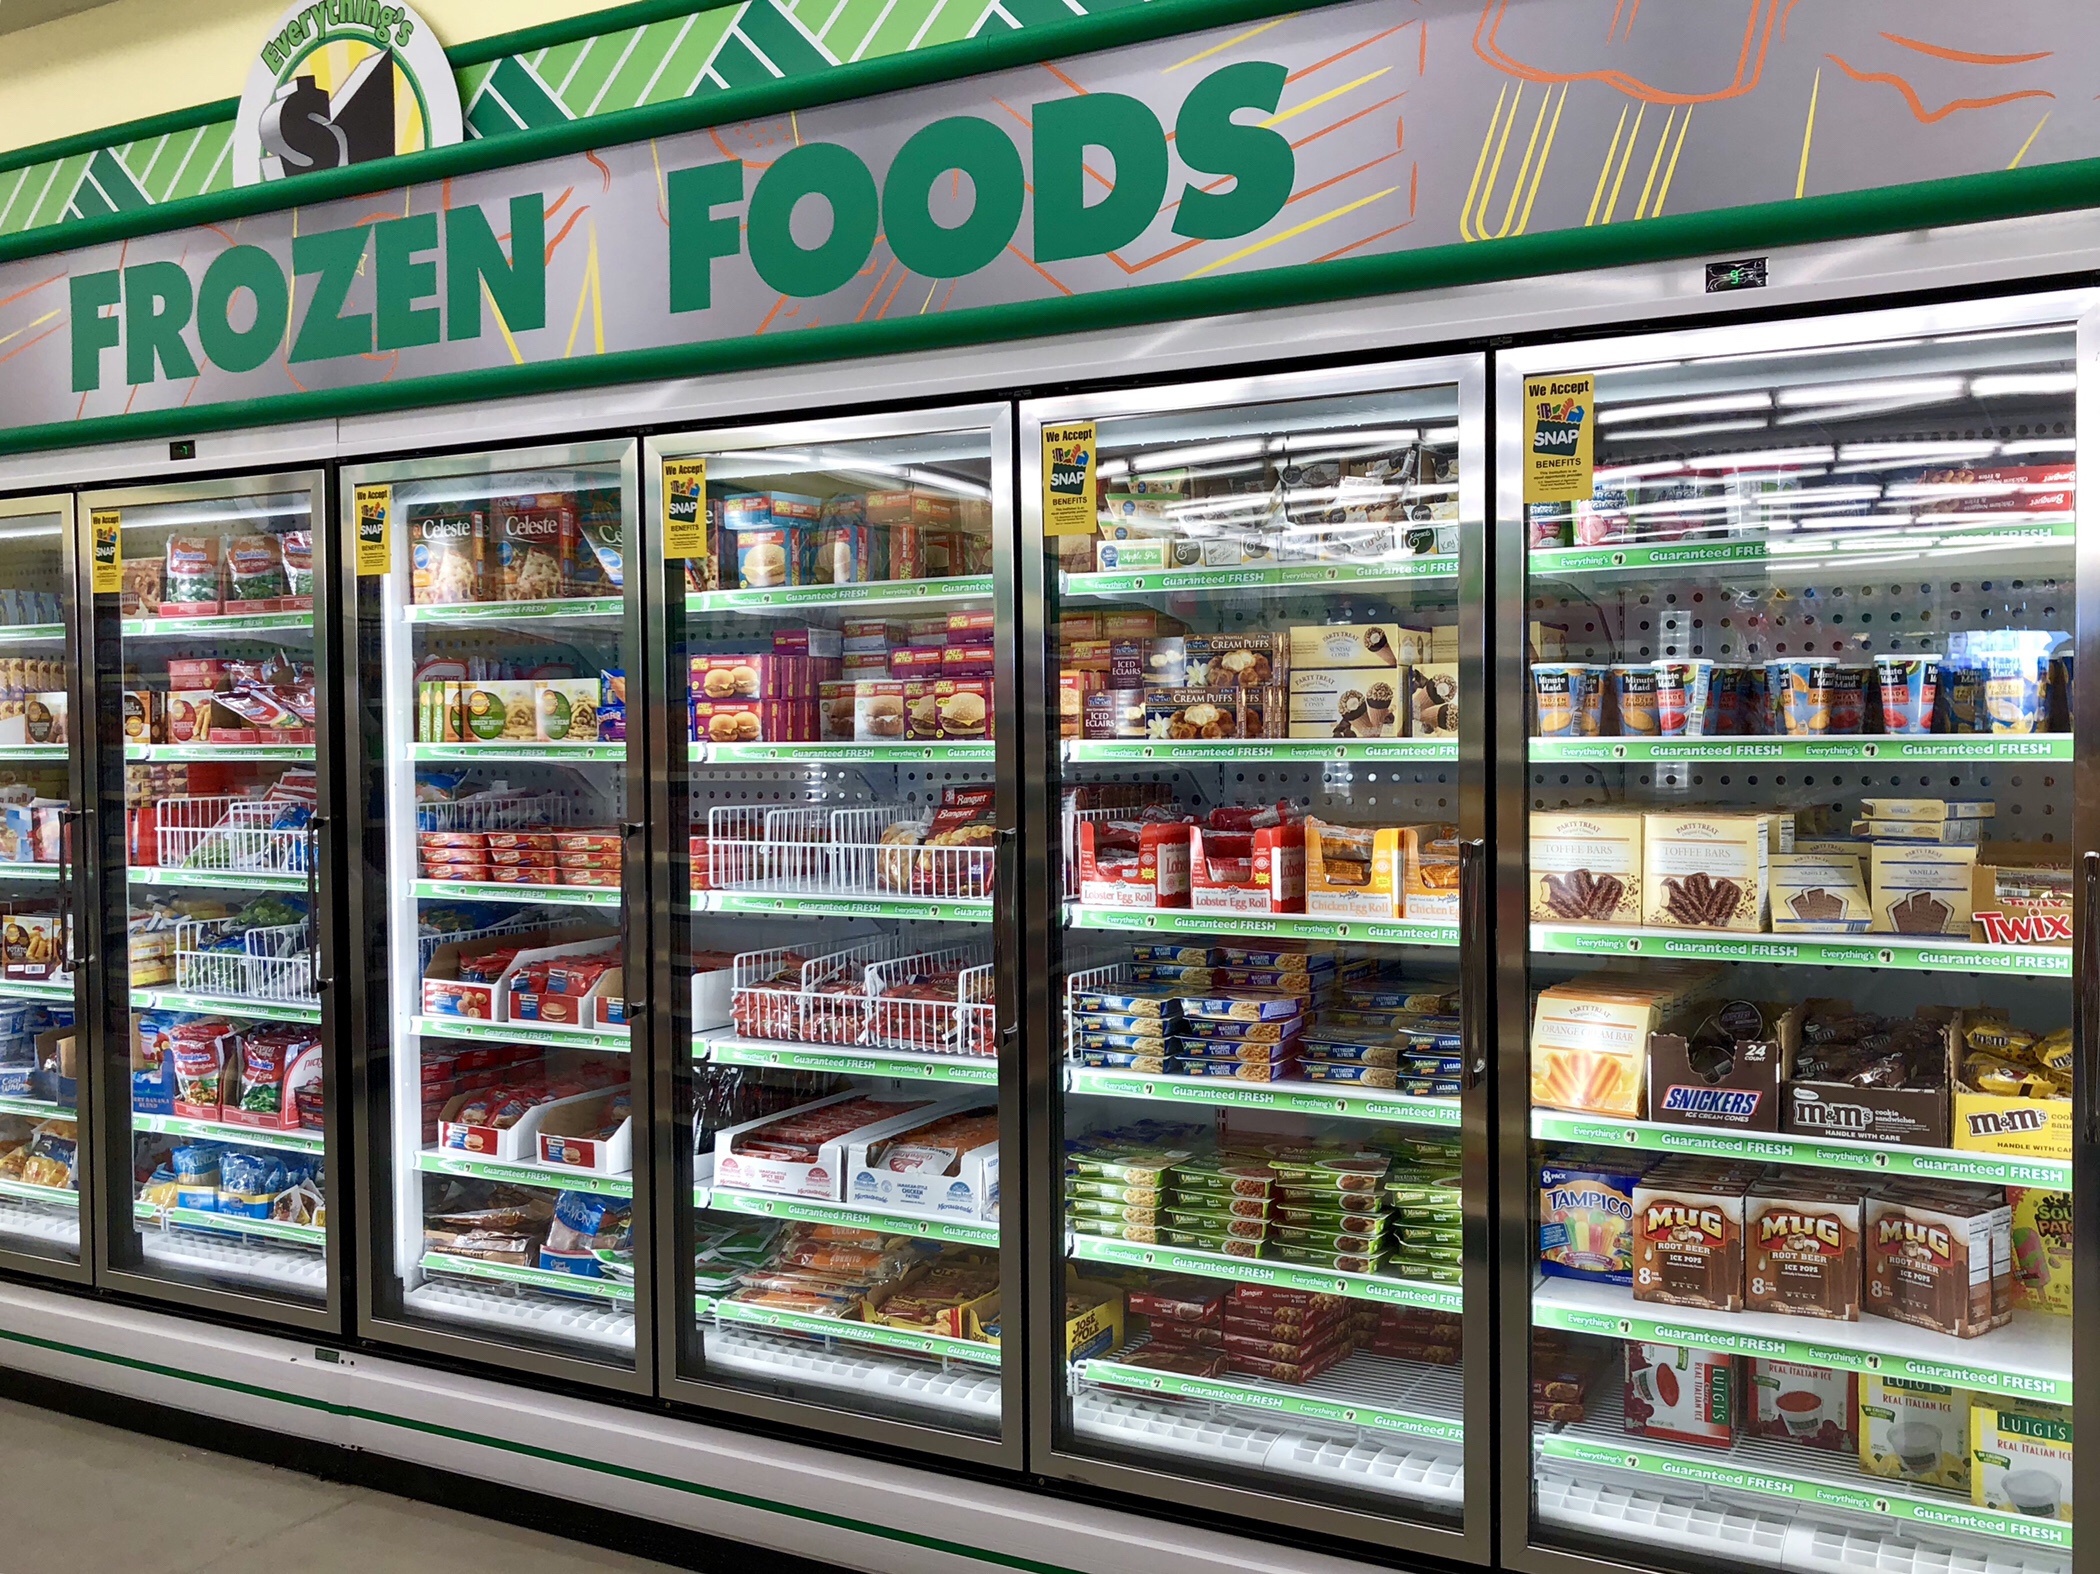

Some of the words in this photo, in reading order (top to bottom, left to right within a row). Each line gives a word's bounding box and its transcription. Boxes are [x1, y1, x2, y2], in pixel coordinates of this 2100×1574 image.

[261, 0, 414, 76] Everything's
[69, 192, 546, 393] FROZEN
[667, 60, 1296, 313] FOODS
[1529, 385, 1546, 397] We
[1550, 381, 1589, 394] Accept
[1046, 432, 1059, 442] We
[1062, 429, 1092, 441] Accept
[1534, 429, 1579, 446] SNAP
[666, 465, 679, 475] We
[680, 464, 703, 475] Accept
[1536, 458, 1581, 469] BENEFITS
[1051, 471, 1085, 486] SNAP
[357, 491, 366, 500] We
[368, 490, 388, 500] Accept
[1053, 497, 1087, 506] BENEFITS
[670, 502, 697, 514] SNAP
[93, 516, 100, 524] We
[102, 516, 118, 525] Accept
[506, 515, 558, 537] Celeste
[360, 524, 384, 535] SNAP
[422, 518, 470, 540] Celeste
[671, 524, 699, 532] BENEFITS
[96, 546, 115, 556] SNAP
[1121, 551, 1142, 562] Apple
[1144, 551, 1158, 560] Pie
[1560, 556, 1608, 567] Everything's
[1649, 547, 1731, 562] Guaranteed
[1163, 574, 1225, 586] Guaranteed
[1228, 573, 1264, 583] FRESH
[1282, 570, 1324, 580] Everything's
[786, 591, 838, 602] Guaranteed
[839, 589, 868, 598] FRESH
[882, 588, 916, 597] Everything's
[1211, 639, 1241, 649] CREAM
[1244, 639, 1269, 648] PUFFS
[1539, 676, 1565, 684] Minute
[1625, 676, 1654, 684] Minute
[1173, 694, 1204, 703] CREAM
[1206, 694, 1233, 703] PUFFS
[1091, 712, 1109, 720] ICED
[1085, 719, 1115, 728] ECLAIRS
[1172, 748, 1234, 757] Guaranteed
[1237, 747, 1273, 756] FRESH
[1561, 747, 1609, 758] Everything's
[1650, 745, 1731, 756] Guaranteed
[1736, 745, 1782, 755] FRESH
[956, 793, 988, 806] Banquet
[937, 809, 975, 819] Banquet
[1557, 821, 1577, 832] PARTY
[1579, 820, 1601, 832] TREAT
[1544, 845, 1584, 854] TOFFEE
[1587, 845, 1613, 855] BARS
[1664, 846, 1702, 857] TOFFEE
[1705, 847, 1731, 858] BARS
[1084, 890, 1114, 899] Lobster
[1117, 892, 1133, 903] Egg
[1135, 892, 1152, 902] Roll
[798, 901, 850, 912] Guaranteed
[851, 903, 881, 913] FRESH
[1196, 896, 1227, 907] Lobster
[1230, 898, 1247, 911] Egg
[1249, 898, 1267, 908] Roll
[1312, 902, 1347, 911] Chicken
[1349, 902, 1367, 915] Egg
[1370, 903, 1388, 912] Roll
[1106, 916, 1144, 925] Everything's
[1174, 917, 1237, 930] Guaranteed
[1240, 920, 1276, 931] FRESH
[1821, 949, 1874, 962] Everything's
[1918, 952, 2010, 967] Guaranteed
[2015, 956, 2069, 969] FRESH
[1568, 1005, 1589, 1015] PARTY
[1591, 1005, 1611, 1018] TREAT
[1542, 1024, 1578, 1036] ORANGE
[1616, 1031, 1634, 1042] BAR
[1744, 1044, 1766, 1057] 24
[1666, 1087, 1757, 1115] SNICKERS
[1699, 1112, 1722, 1121] CREAM
[1724, 1115, 1749, 1123] CONES
[1825, 1129, 1855, 1137] HANDLE
[1573, 1127, 1620, 1139] Everything's
[1661, 1134, 1742, 1151] Guaranteed
[1747, 1142, 1794, 1156] FRESH
[483, 1165, 525, 1179] Guaranteed
[526, 1171, 551, 1182] FRESH
[1543, 1170, 1551, 1184] 8
[1547, 1190, 1632, 1220] TAMPICO
[788, 1205, 839, 1220] Guaranteed
[841, 1211, 870, 1224] FRESH
[883, 1218, 917, 1229] Everything's
[1647, 1206, 1725, 1238] MUG
[1761, 1215, 1841, 1246] MUG
[1878, 1220, 1951, 1259] MUG
[1658, 1242, 1680, 1251] ROOT
[1683, 1244, 1711, 1254] BEER
[1684, 1256, 1702, 1264] POPS
[1889, 1256, 1912, 1266] ROOT
[1915, 1260, 1939, 1273] BEER
[1172, 1257, 1236, 1274] Guaranteed
[1238, 1265, 1275, 1280] FRESH
[1292, 1274, 1333, 1289] Everything's
[1638, 1268, 1651, 1284] 8
[1695, 1362, 1703, 1378] REAL
[1808, 1349, 1862, 1365] Everything's
[1905, 1361, 1998, 1385] Guaranteed
[2002, 1376, 2055, 1394] FRESH
[1695, 1383, 1703, 1408] ITALIAN
[1713, 1369, 1725, 1420] LUIGI'S
[1883, 1394, 1903, 1405] REAL
[1905, 1397, 1937, 1410] ITALIAN
[1940, 1402, 1952, 1412] ICE
[1695, 1411, 1703, 1421] ICE
[2002, 1417, 2066, 1440] LUIGI'S
[1997, 1439, 2018, 1451] REAL
[2022, 1444, 2055, 1457] ITALIAN
[2059, 1451, 2072, 1461] ICE
[1575, 1449, 1622, 1464] Everything's
[1662, 1462, 1742, 1484] Guaranteed
[1747, 1477, 1794, 1494] FRESH
